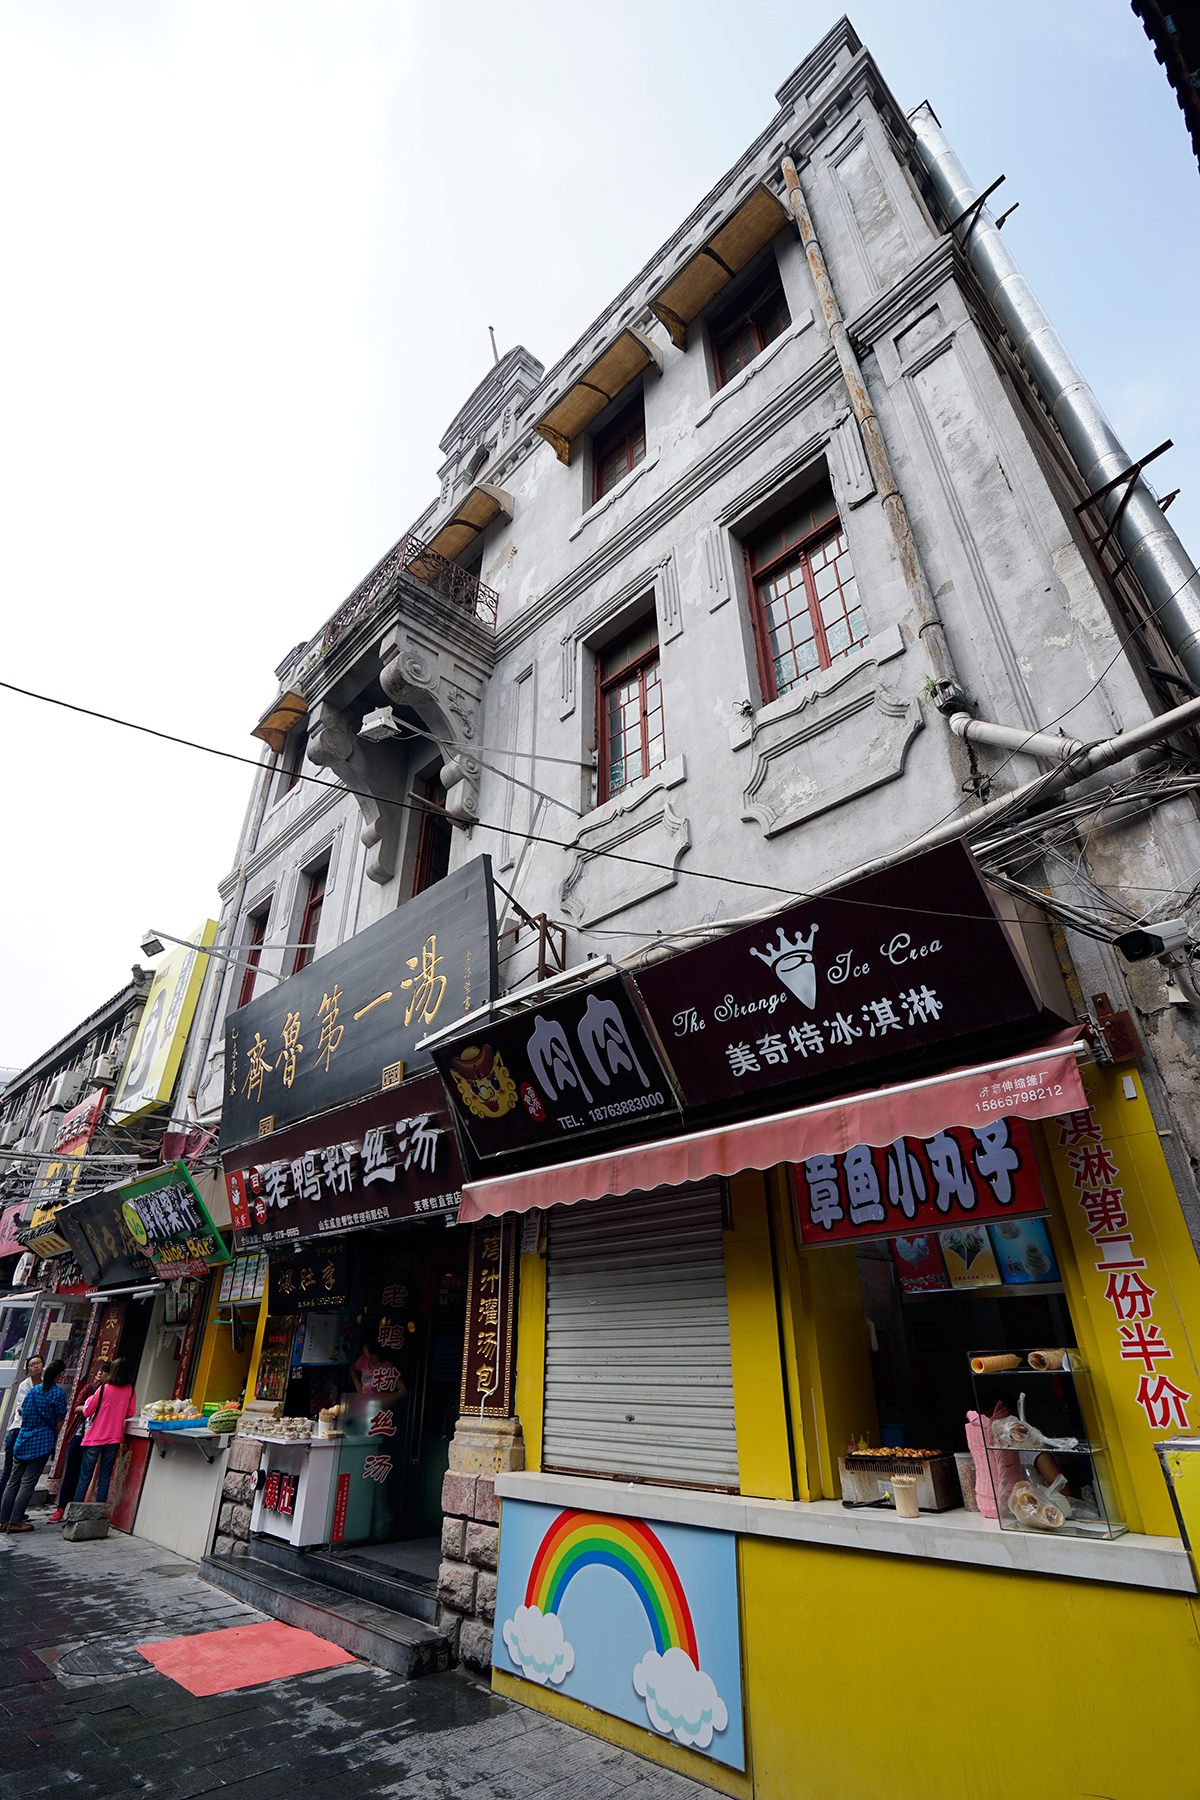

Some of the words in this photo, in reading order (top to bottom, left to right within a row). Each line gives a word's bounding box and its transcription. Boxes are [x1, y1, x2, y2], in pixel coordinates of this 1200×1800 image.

[827, 949, 870, 984] Ice
[879, 932, 943, 965] Crea
[672, 1006, 706, 1037] The
[713, 994, 788, 1022] Strange
[725, 984, 944, 1077] 美奇特冰淇淋
[588, 1092, 665, 1122] 18763883000
[975, 1084, 1063, 1112] 15866798212
[265, 1116, 438, 1209] 老鸭粉丝汤
[805, 1118, 1019, 1230] 章鱼小丸子
[413, 1191, 462, 1212] 芙蓉街直营店
[157, 1243, 186, 1264] Juice
[186, 1239, 211, 1259] Bar
[1053, 1070, 1192, 1430] 淇淋第二份半价
[475, 1235, 501, 1397] 鸡汁灌汤包
[362, 1283, 409, 1484] 老鸭粉丝汤
[263, 1470, 296, 1516] 爆肚
